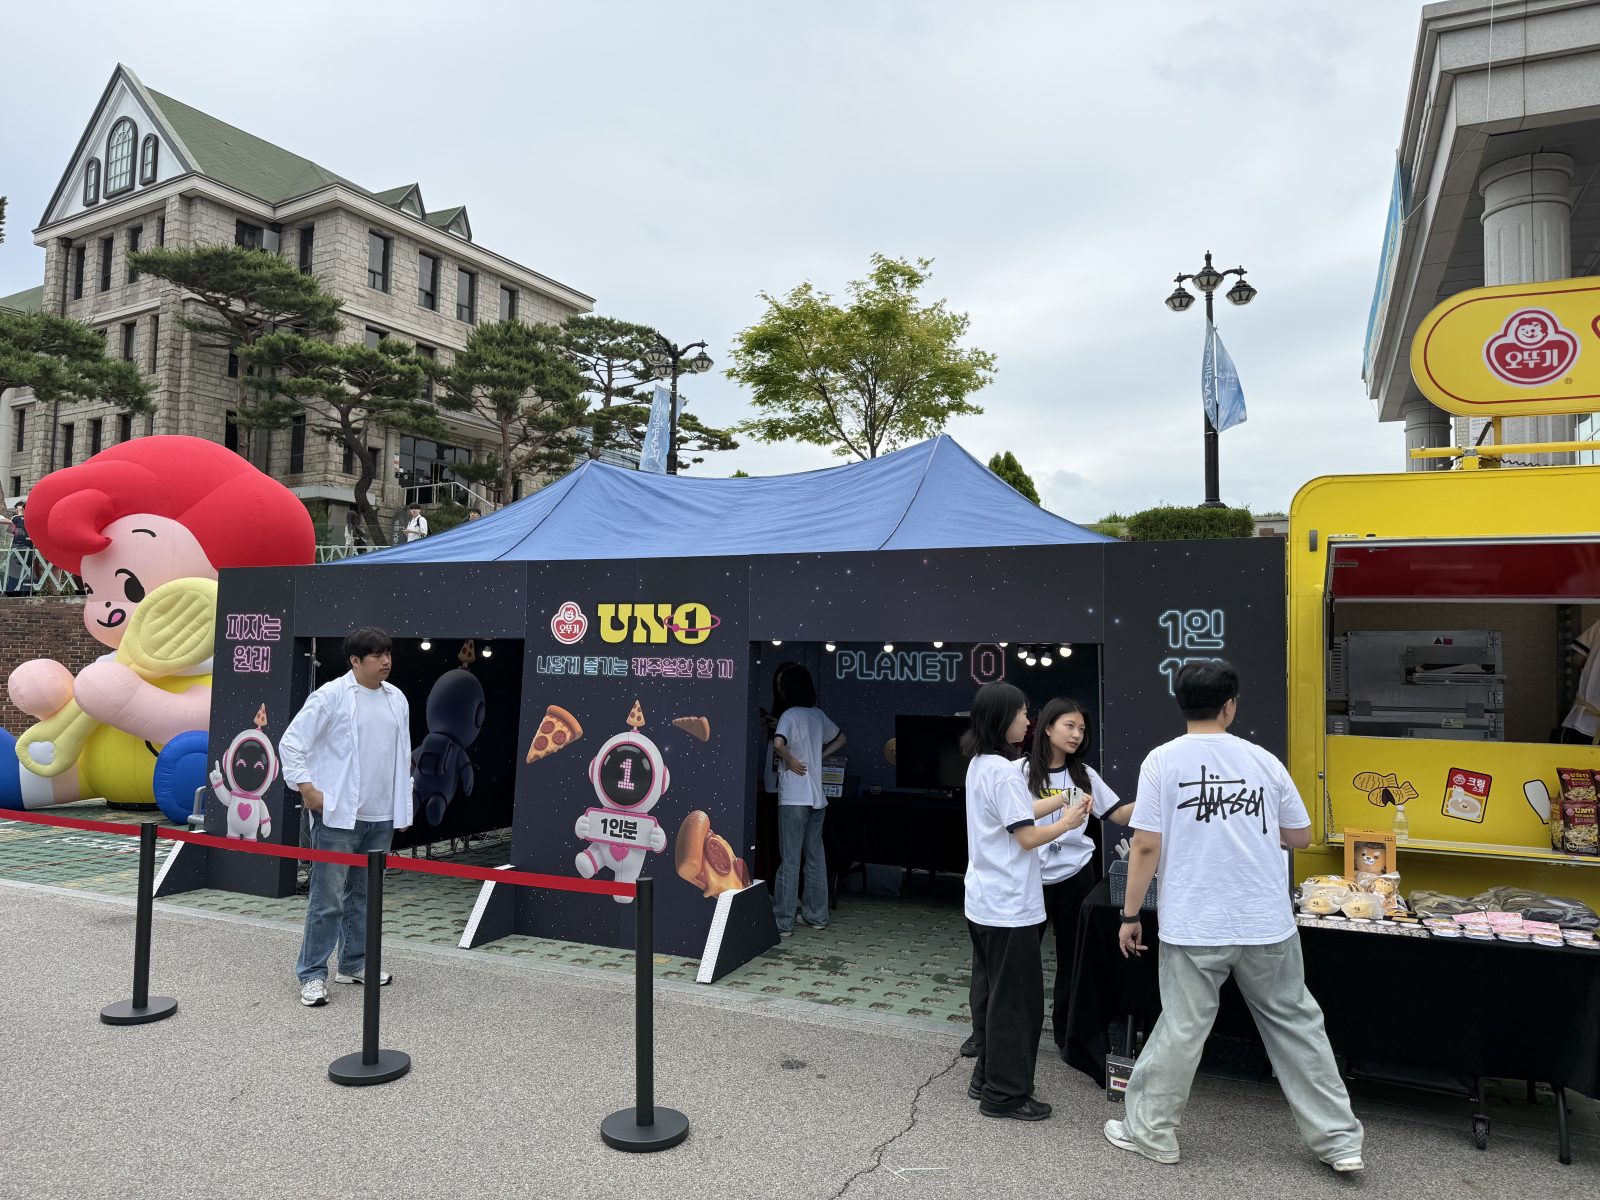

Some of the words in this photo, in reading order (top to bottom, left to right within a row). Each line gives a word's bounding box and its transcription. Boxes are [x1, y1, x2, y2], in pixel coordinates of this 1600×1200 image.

[1504, 348, 1559, 369] 오뚜기
[225, 613, 282, 641] 피자는
[558, 623, 580, 635] 오뚜기
[1159, 609, 1224, 649] 1인
[233, 645, 271, 673] 원래
[536, 655, 580, 675] 나답게
[583, 656, 629, 676] 즐기는
[631, 656, 695, 678] 캐주얼한
[696, 657, 714, 679] 한
[836, 650, 963, 682] PLANET
[617, 758, 635, 790] 1
[600, 818, 638, 840] 1인분
